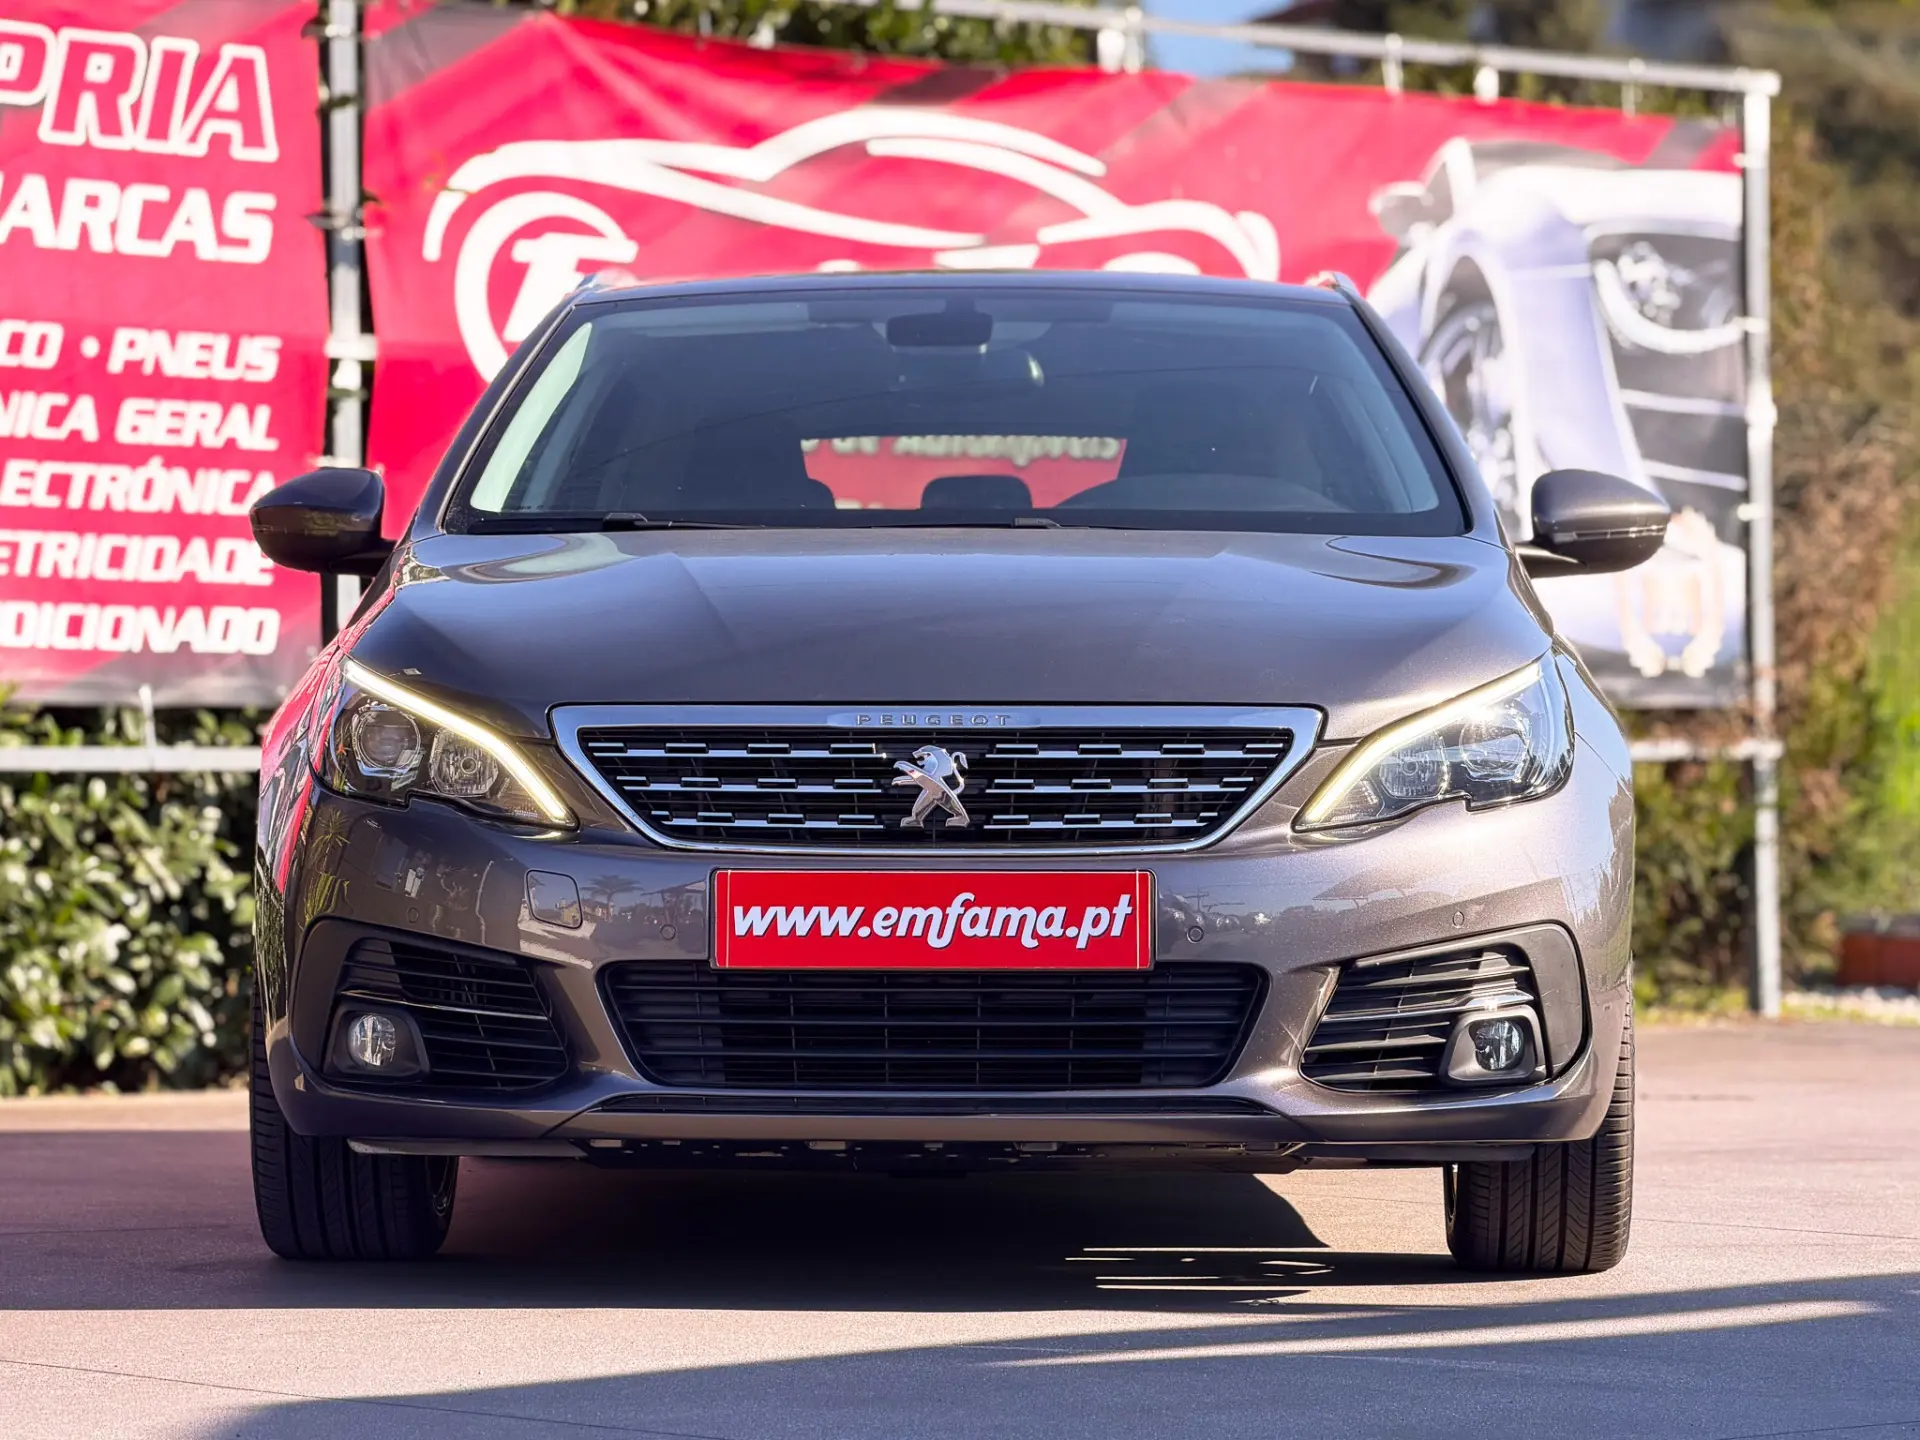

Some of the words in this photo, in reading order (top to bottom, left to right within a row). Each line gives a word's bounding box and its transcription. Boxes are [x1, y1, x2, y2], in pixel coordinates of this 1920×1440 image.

[0, 171, 277, 264] ARCAS
[107, 328, 282, 382] PNEUS
[115, 397, 278, 451] GERAL
[857, 714, 1011, 726] PEUGEOT
[733, 892, 1133, 949] www.emfama.pt
